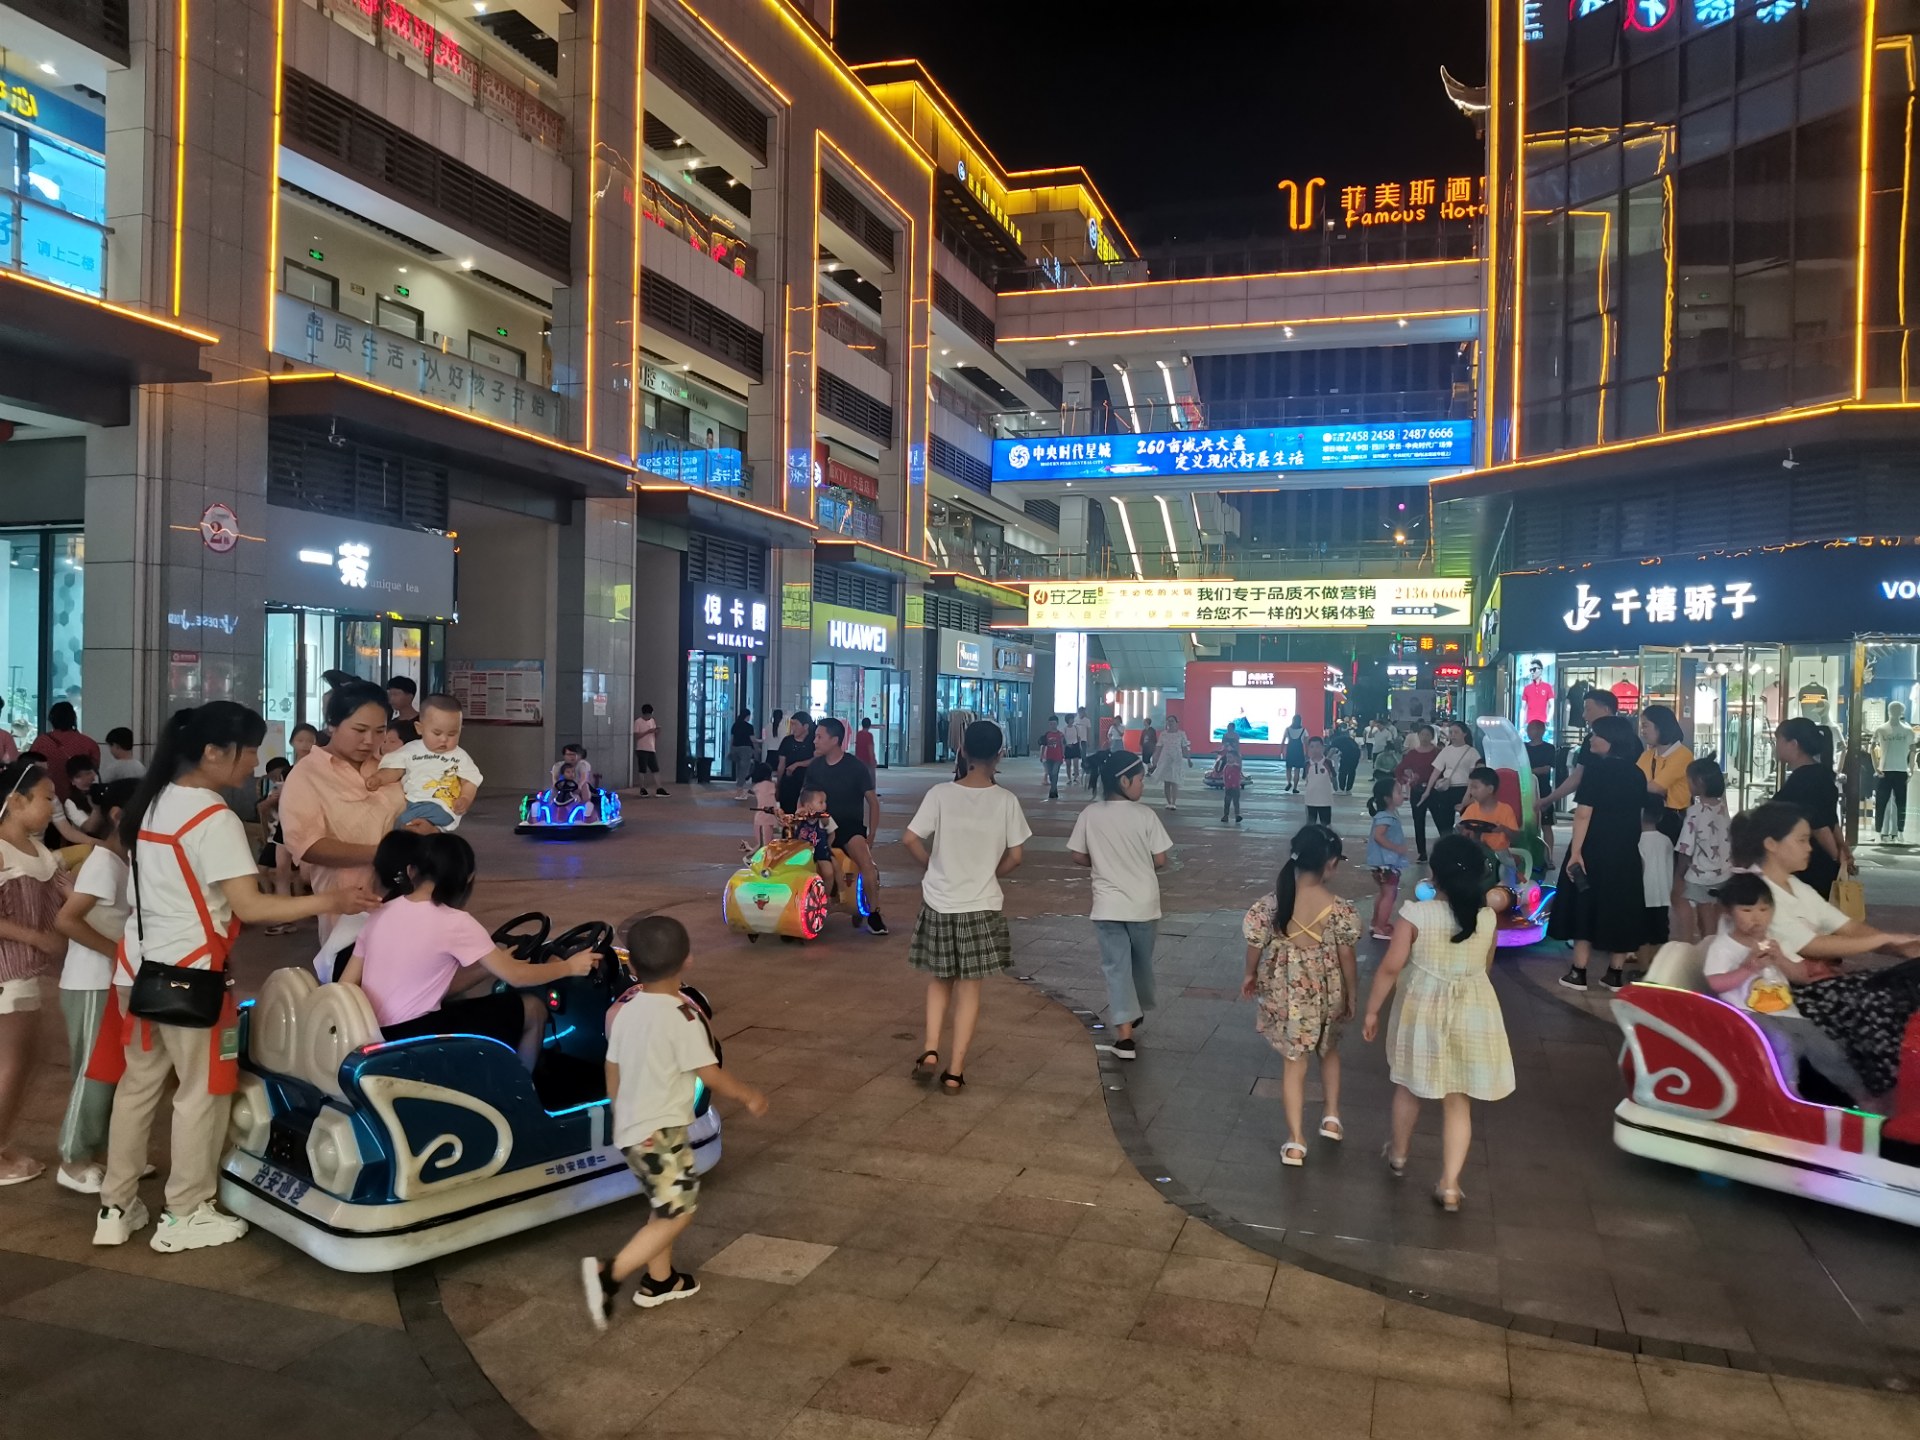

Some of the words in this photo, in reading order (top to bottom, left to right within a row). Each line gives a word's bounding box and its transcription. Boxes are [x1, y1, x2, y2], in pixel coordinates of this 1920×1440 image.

[1341, 176, 1488, 209] 菲美斯酒
[1345, 207, 1426, 229] Famous
[1345, 431, 1369, 442] 2458
[1371, 430, 1396, 441] 2458
[1402, 428, 1426, 440] 2487
[1428, 427, 1454, 439] 6666
[1033, 441, 1112, 461] 中央时代星城
[299, 542, 370, 588] 一茶
[1197, 585, 1377, 600] 我们专于品质不做营销
[1882, 580, 1920, 600] VO
[1197, 605, 1376, 620] 给您不一样的火锅体验
[1612, 582, 1757, 625] 千禧骄子
[828, 620, 888, 653] HUAWEI
